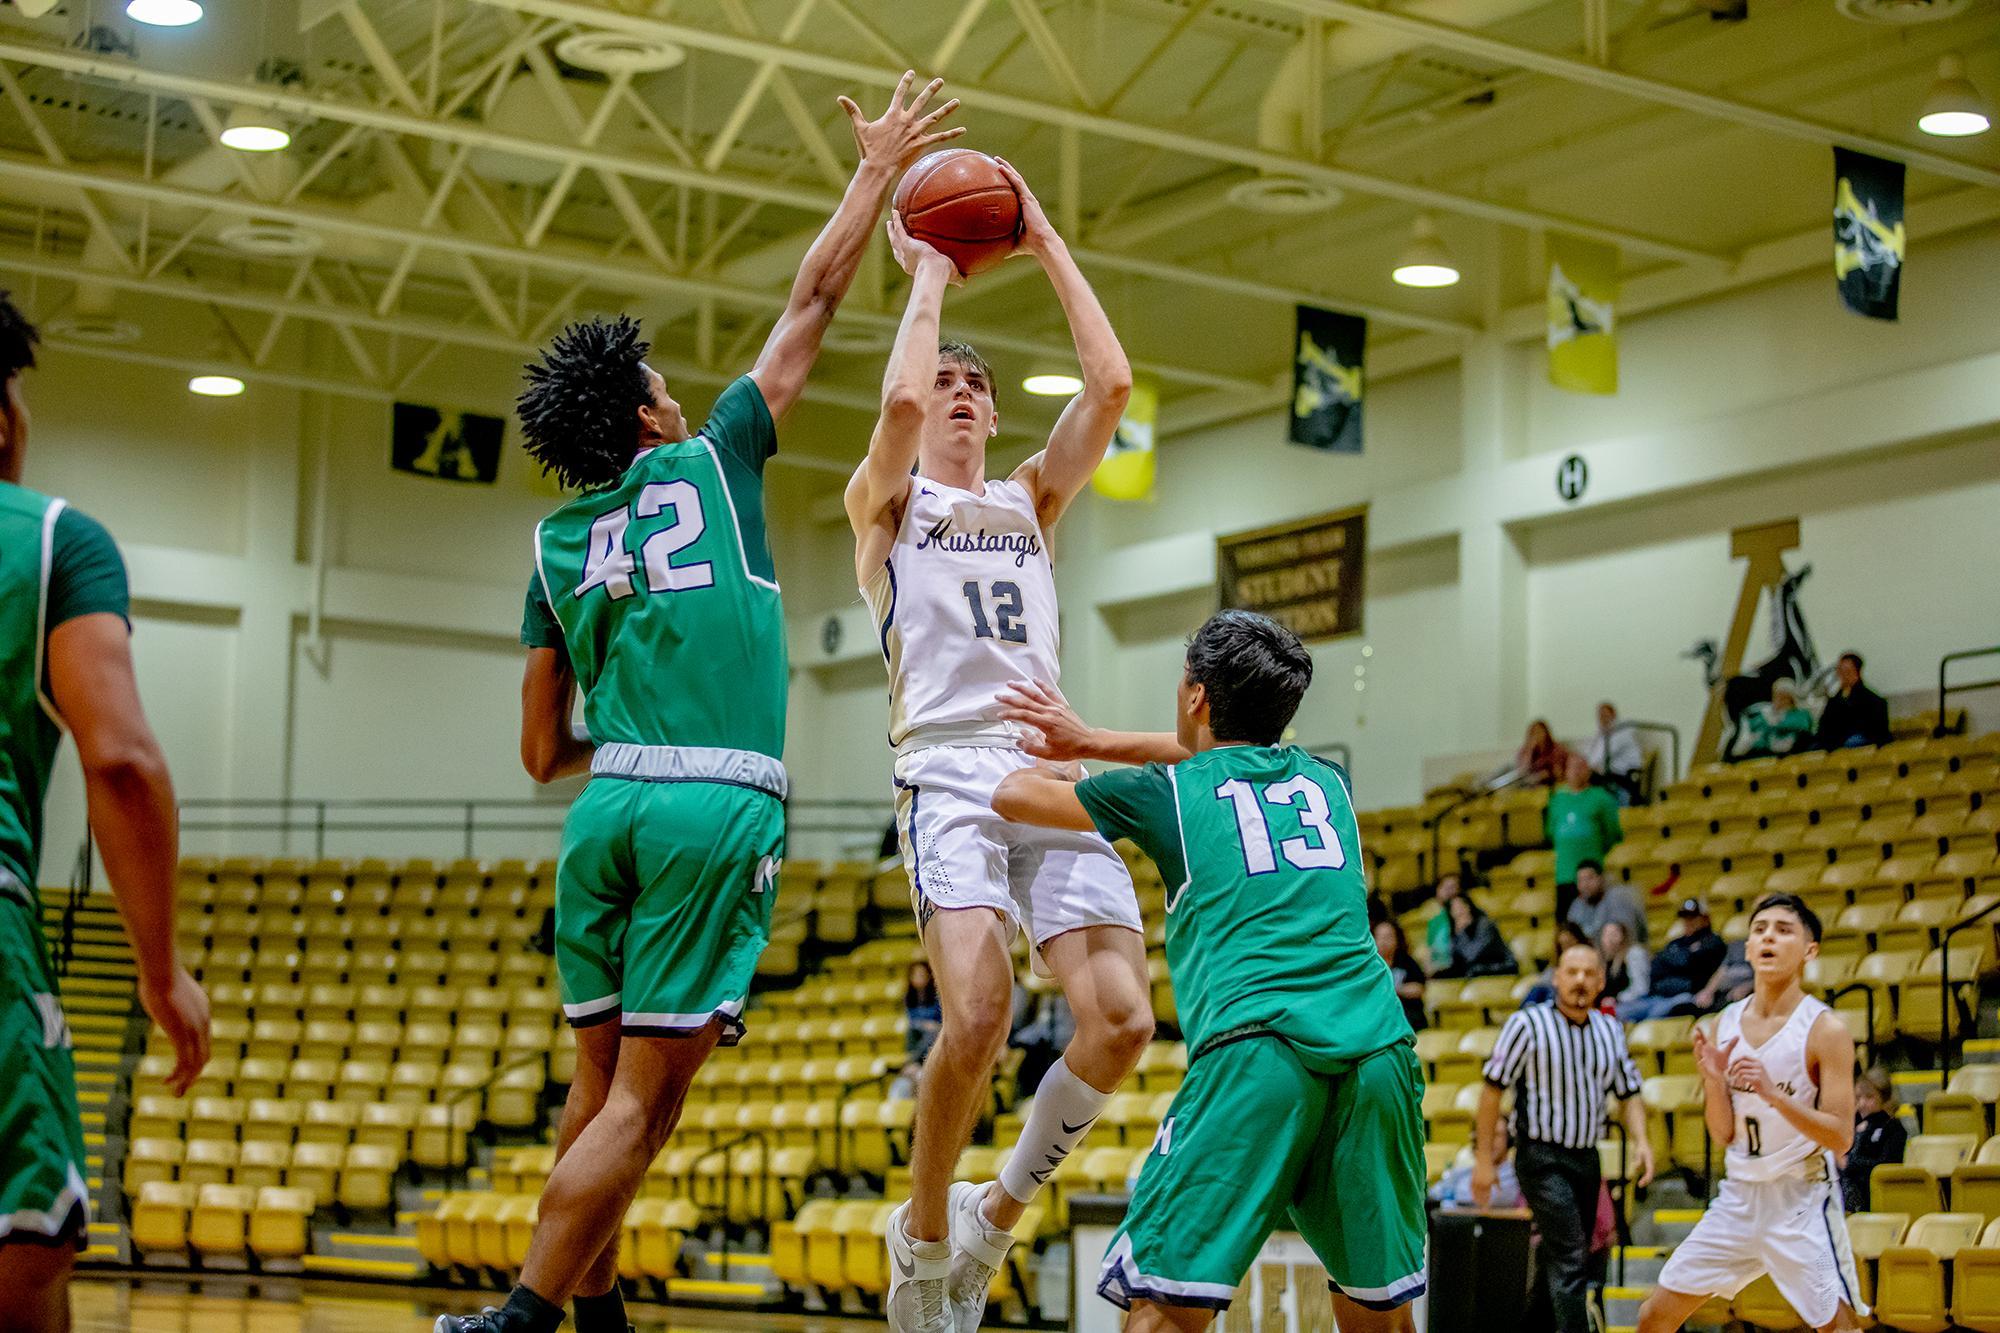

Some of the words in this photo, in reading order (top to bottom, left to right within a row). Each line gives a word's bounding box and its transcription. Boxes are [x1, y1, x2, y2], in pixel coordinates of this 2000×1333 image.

[1562, 459, 1584, 498] H
[573, 478, 715, 601] 42
[917, 518, 1041, 568] Mustangs
[962, 579, 1028, 645] 12
[1214, 773, 1346, 877] 13
